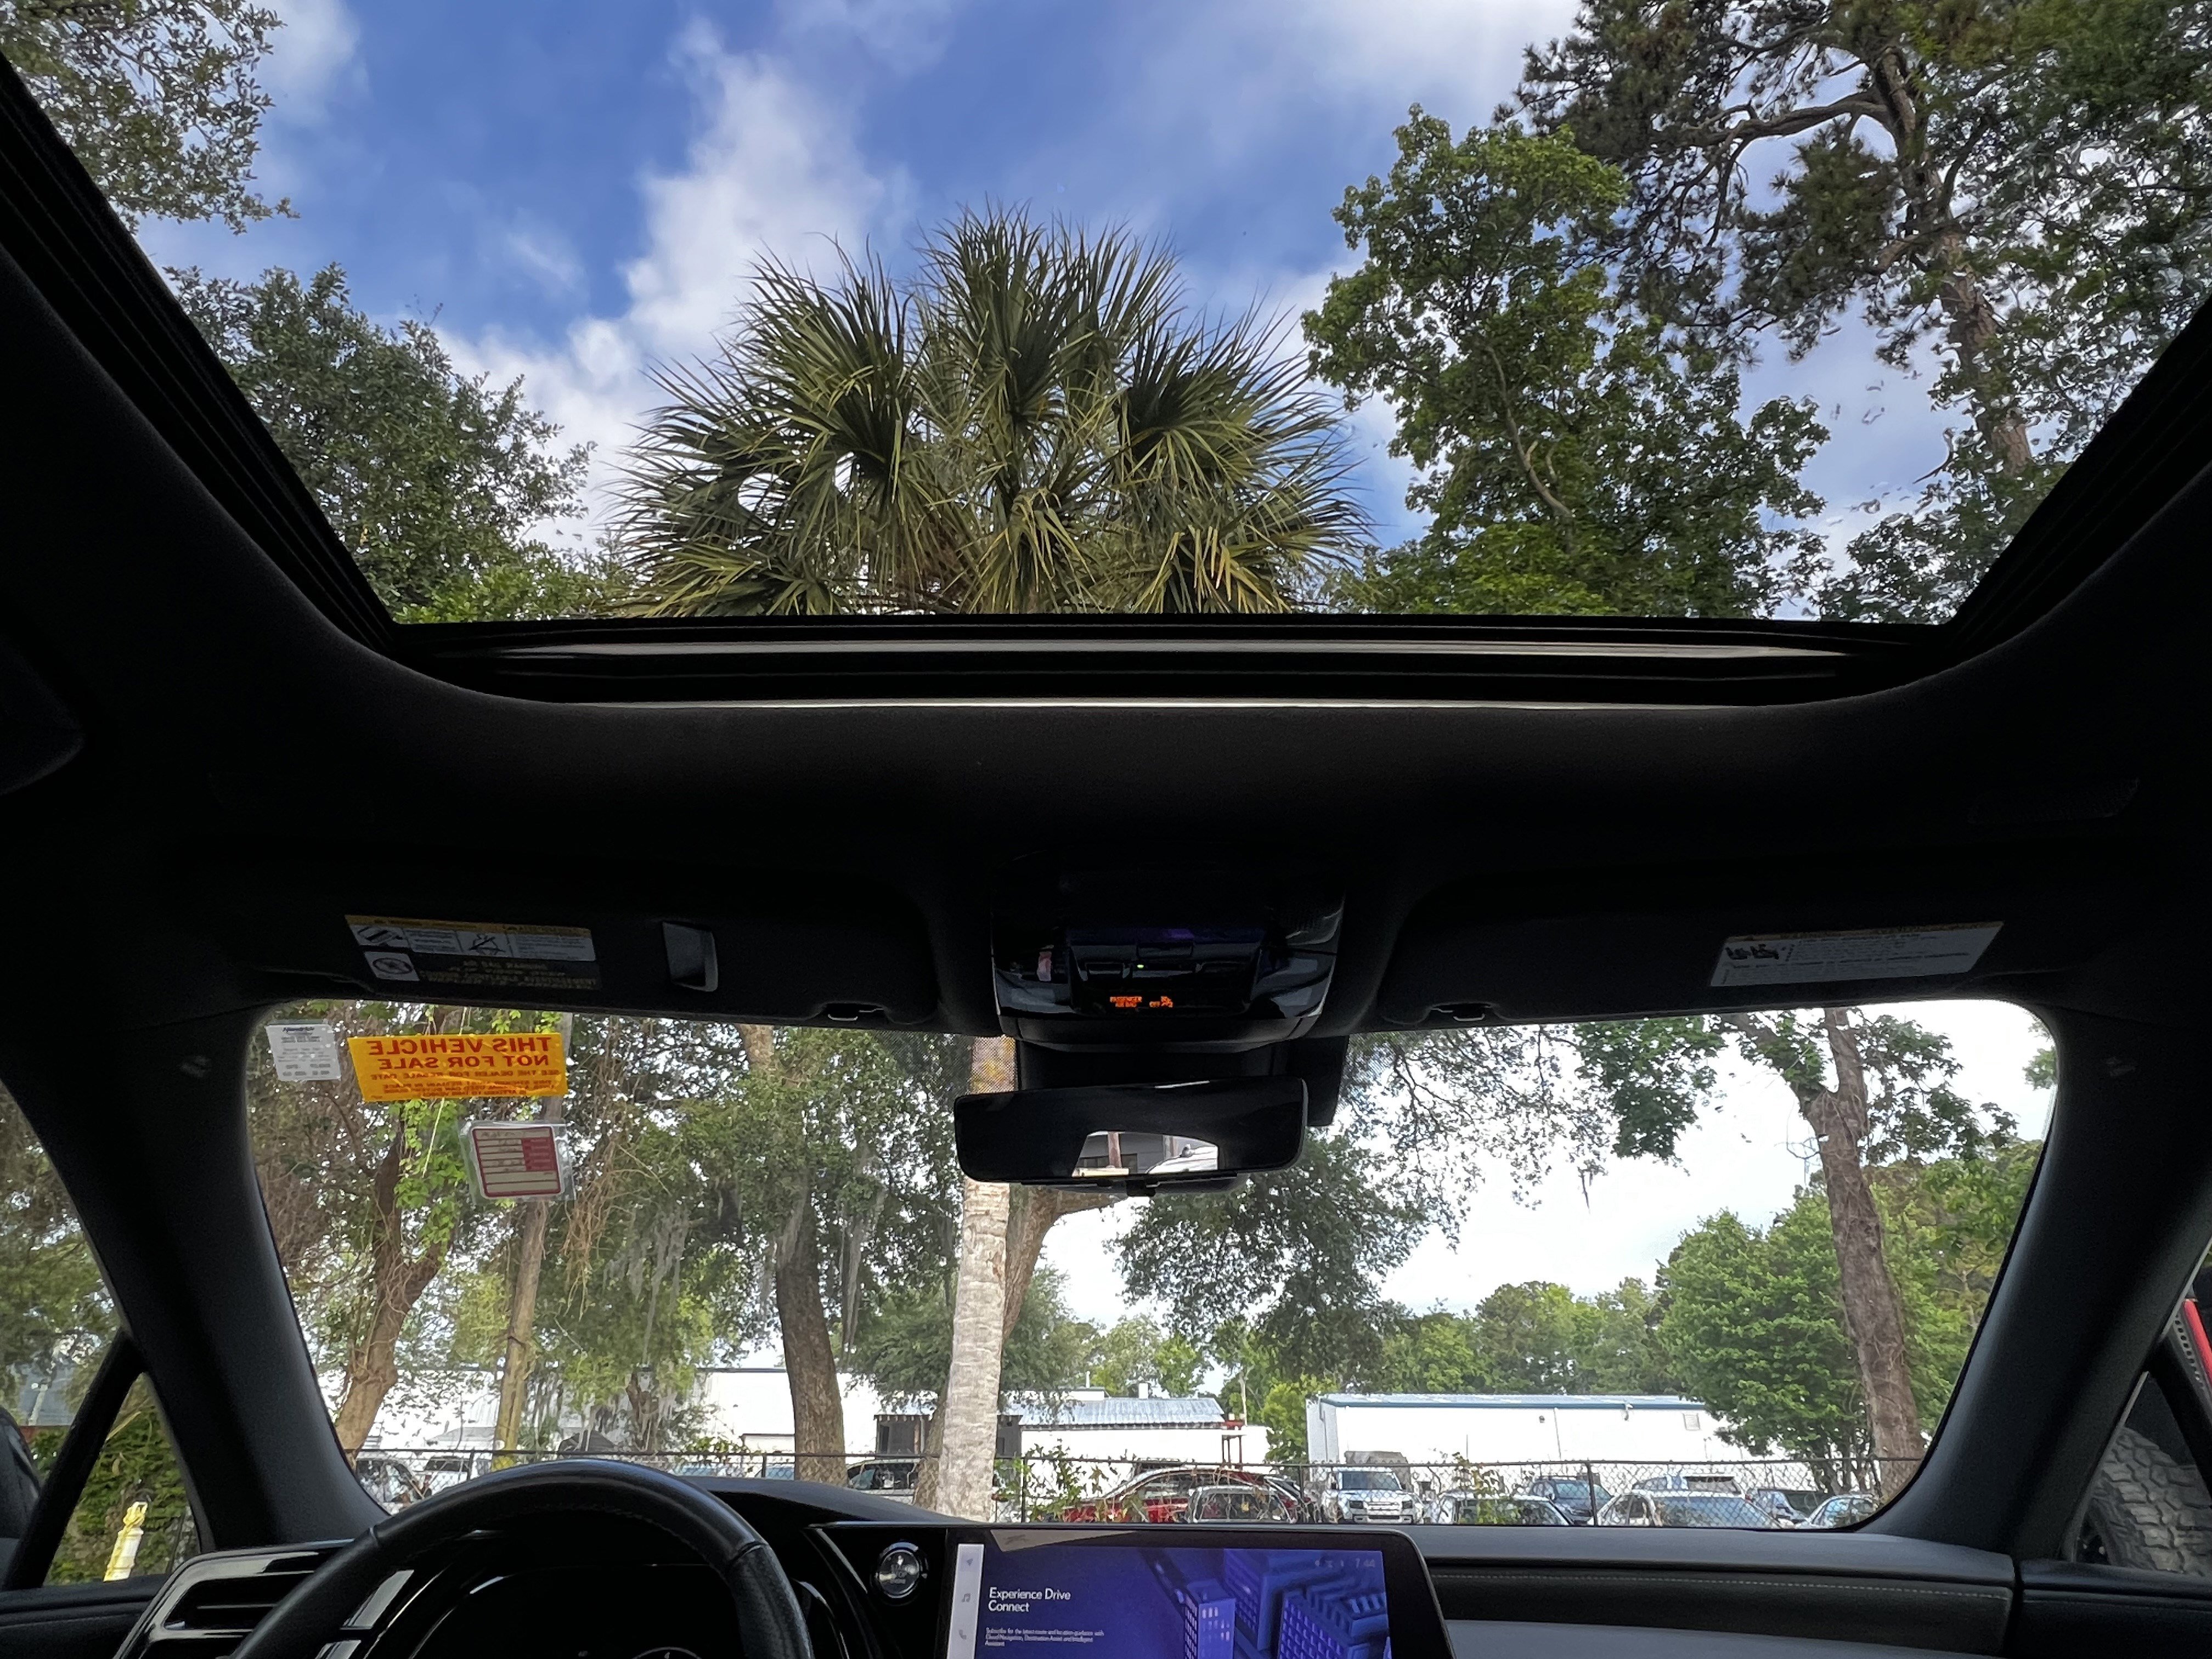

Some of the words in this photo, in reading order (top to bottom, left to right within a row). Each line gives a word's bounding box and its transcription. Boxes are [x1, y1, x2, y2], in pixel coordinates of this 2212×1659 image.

[989, 1587, 1042, 1601] Experience
[1044, 1588, 1071, 1600] Drive
[988, 1600, 1030, 1612] Connect
